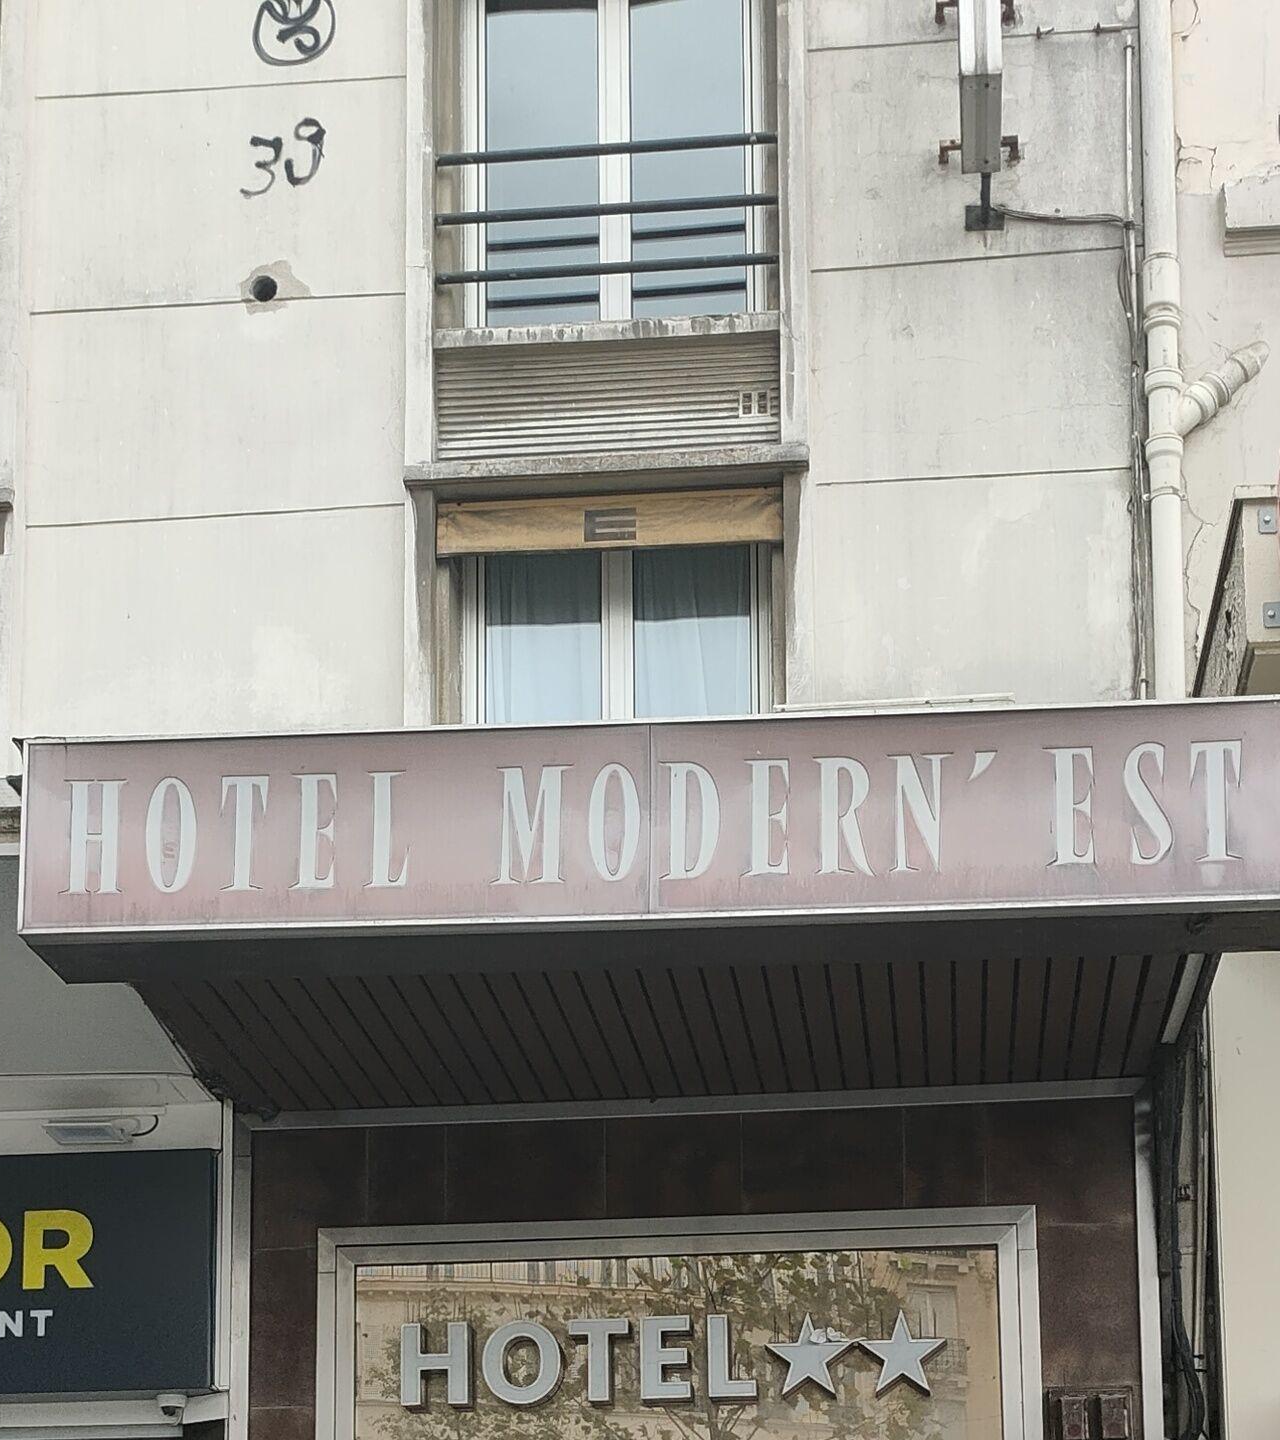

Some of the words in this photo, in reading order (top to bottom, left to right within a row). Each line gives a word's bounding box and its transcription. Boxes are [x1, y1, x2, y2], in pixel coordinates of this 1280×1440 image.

[584, 508, 636, 542] E
[64, 769, 412, 895] HOTEL
[1046, 739, 1243, 868] EST
[399, 1313, 758, 1408] HOTEL
